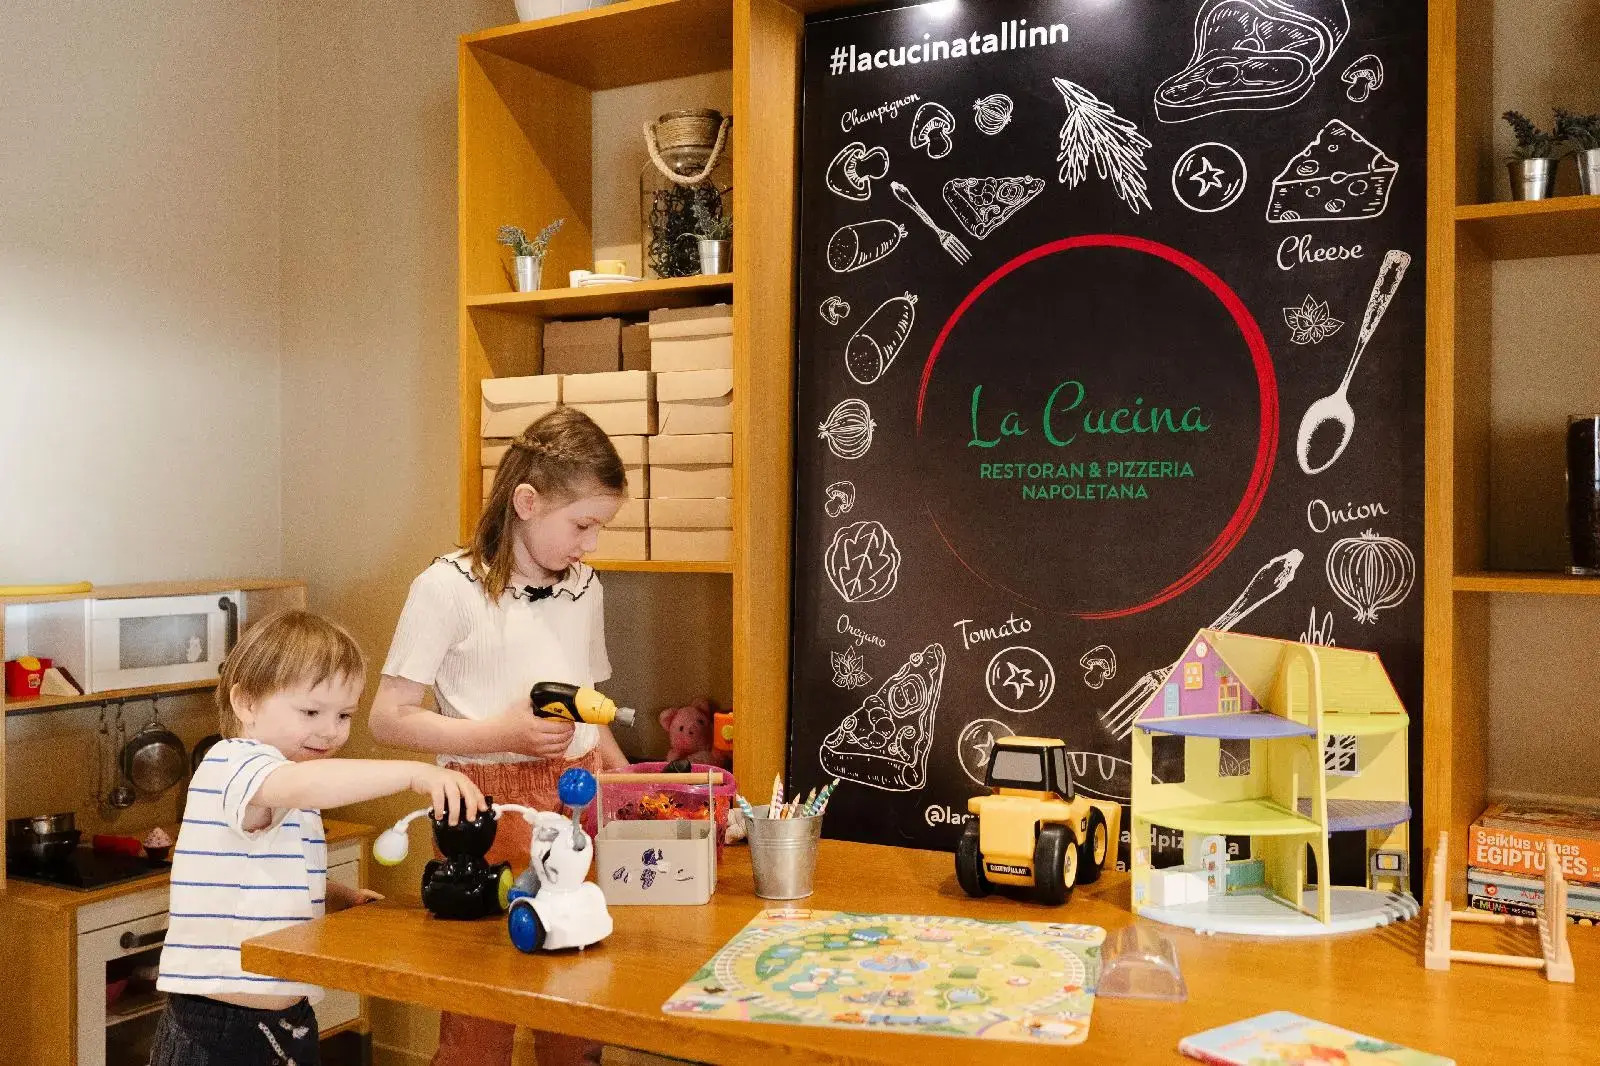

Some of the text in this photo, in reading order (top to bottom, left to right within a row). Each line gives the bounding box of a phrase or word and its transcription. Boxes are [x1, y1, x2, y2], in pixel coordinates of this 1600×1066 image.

[829, 18, 1069, 76] #lacucinatallinn
[841, 93, 921, 133] Champignon
[1276, 233, 1365, 271] Cheese
[967, 380, 1212, 448] La Cucina
[980, 461, 1195, 479] RESTORAN & PIZZERIA
[1022, 484, 1149, 500] NAPOLETANA
[1307, 499, 1390, 533] Onion
[836, 613, 887, 648] Oregano
[953, 612, 1032, 650] Tomato
[1476, 845, 1588, 876] EGIPTUES
[1477, 831, 1580, 856] Seiklus vnas
